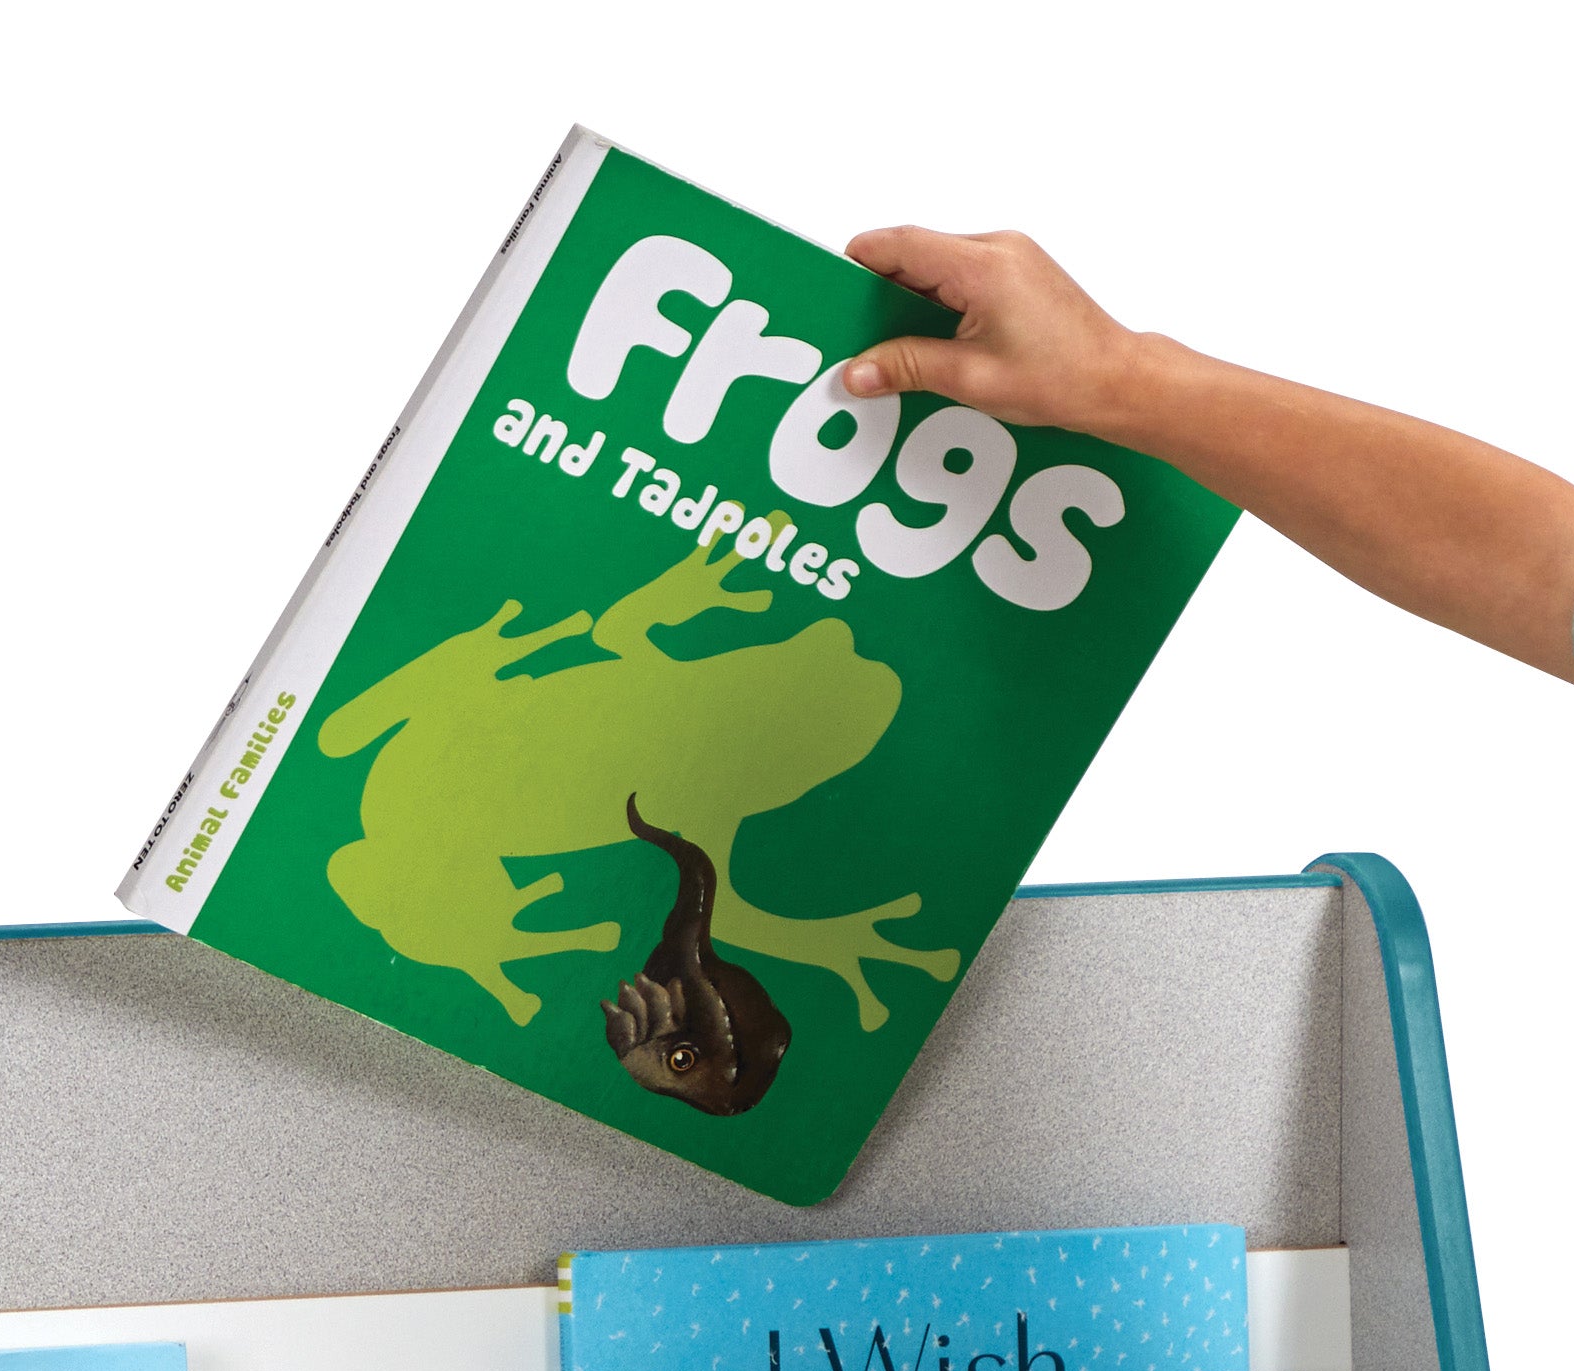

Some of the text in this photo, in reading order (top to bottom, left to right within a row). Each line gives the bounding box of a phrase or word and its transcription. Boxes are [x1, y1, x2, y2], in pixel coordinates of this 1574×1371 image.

[533, 153, 562, 201] Animal
[492, 397, 862, 600] and Tadpoles
[566, 234, 1126, 612] Frogs
[133, 771, 195, 870] ZERO TO TEN
[165, 690, 297, 893] Animal Families
